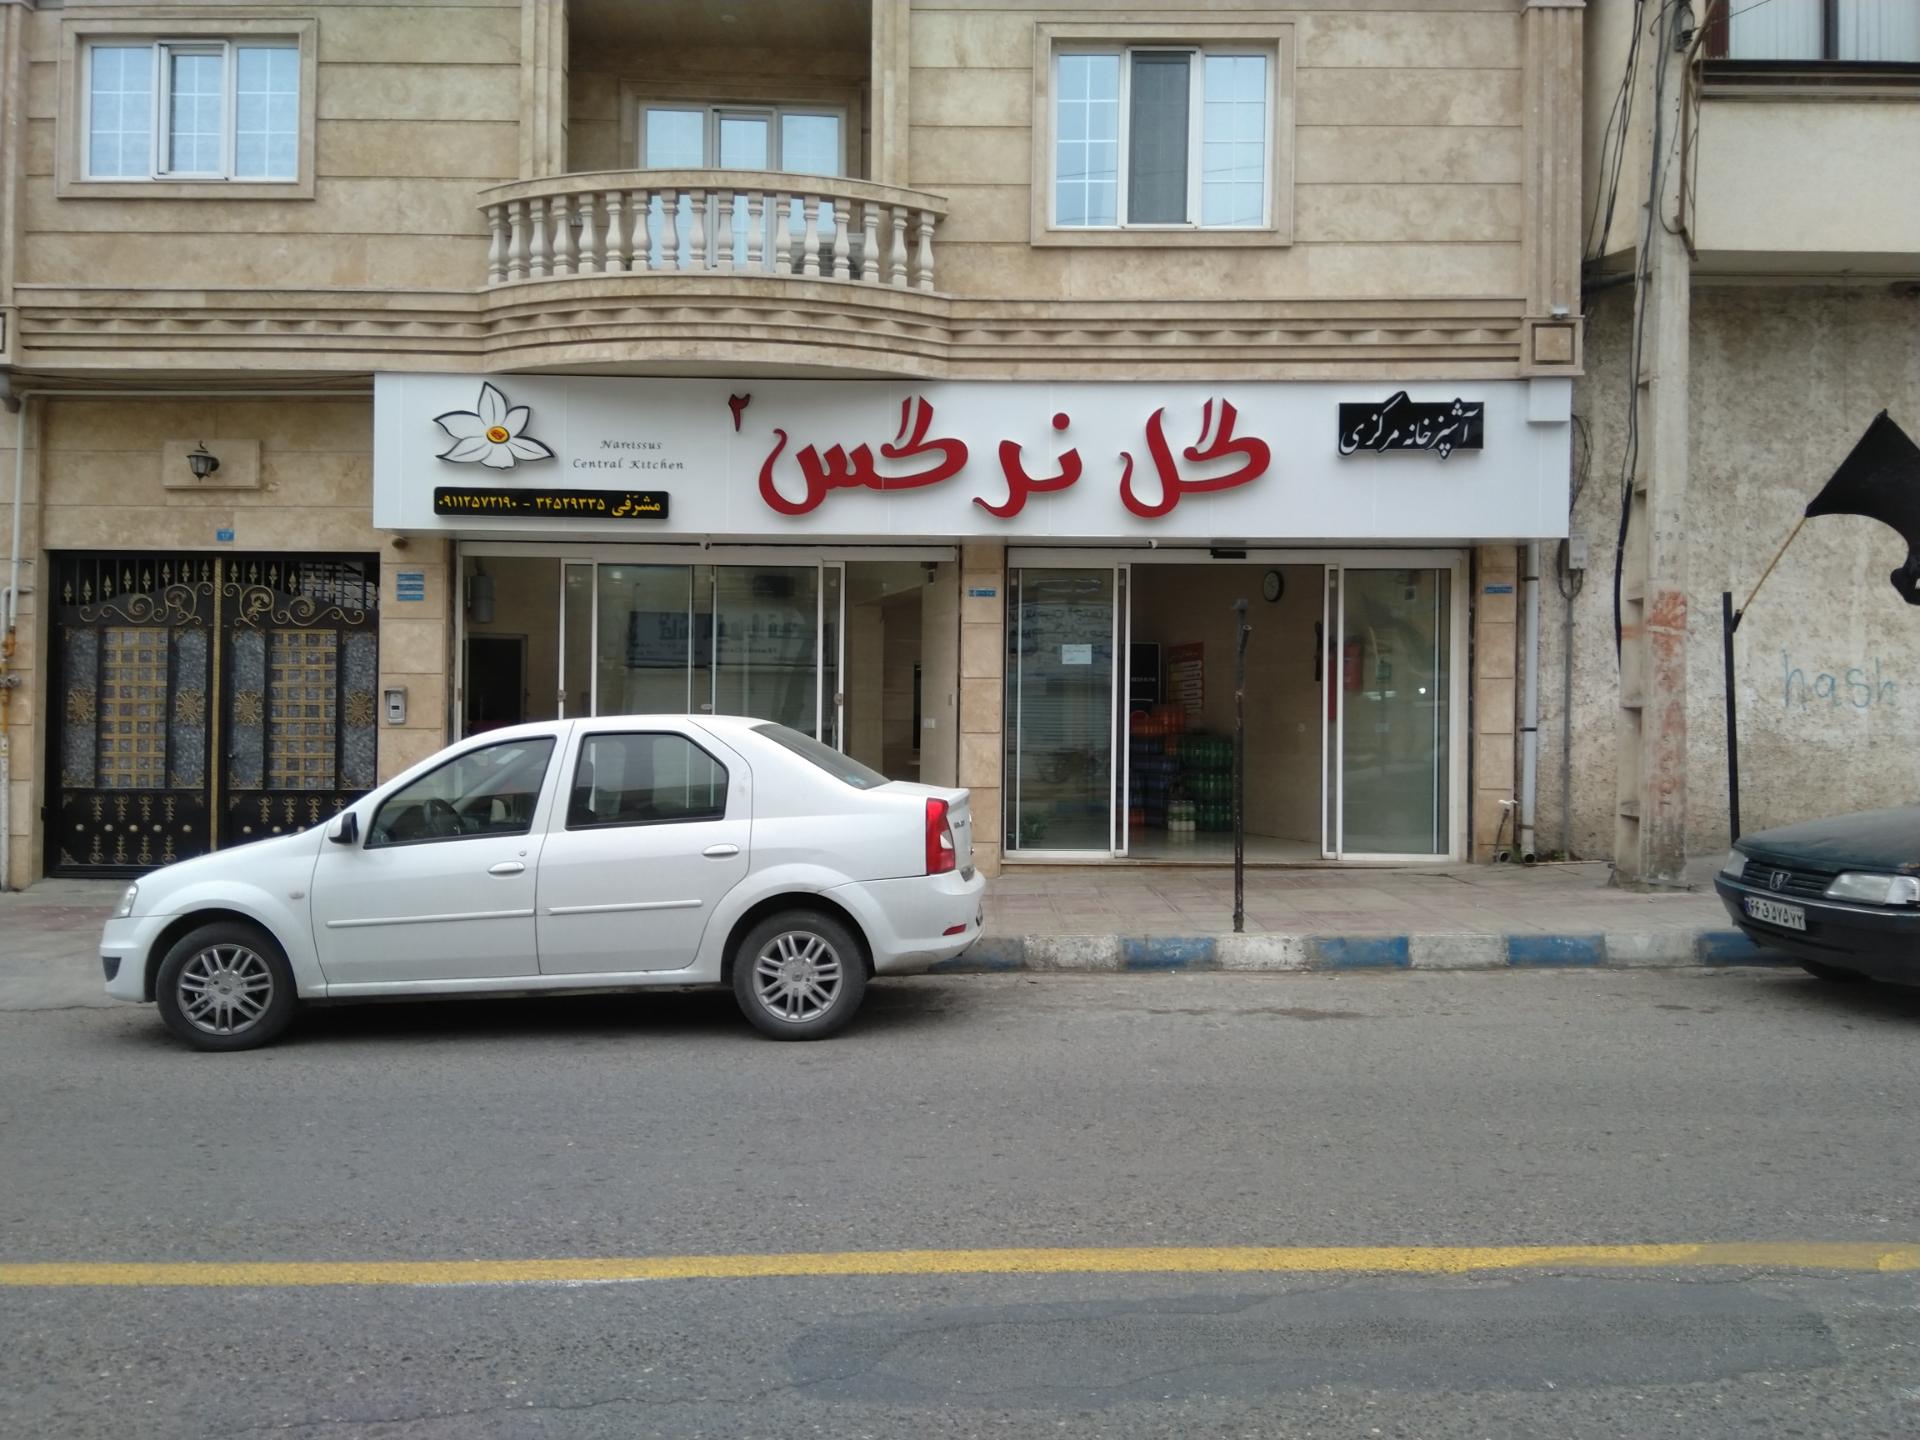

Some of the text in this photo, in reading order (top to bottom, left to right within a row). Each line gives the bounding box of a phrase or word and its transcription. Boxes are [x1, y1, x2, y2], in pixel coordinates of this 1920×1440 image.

[728, 393, 1271, 520] گل نرگس ۲
[1339, 393, 1479, 457] آشپزخانه مرکزی
[572, 457, 684, 470] Central Kitchen
